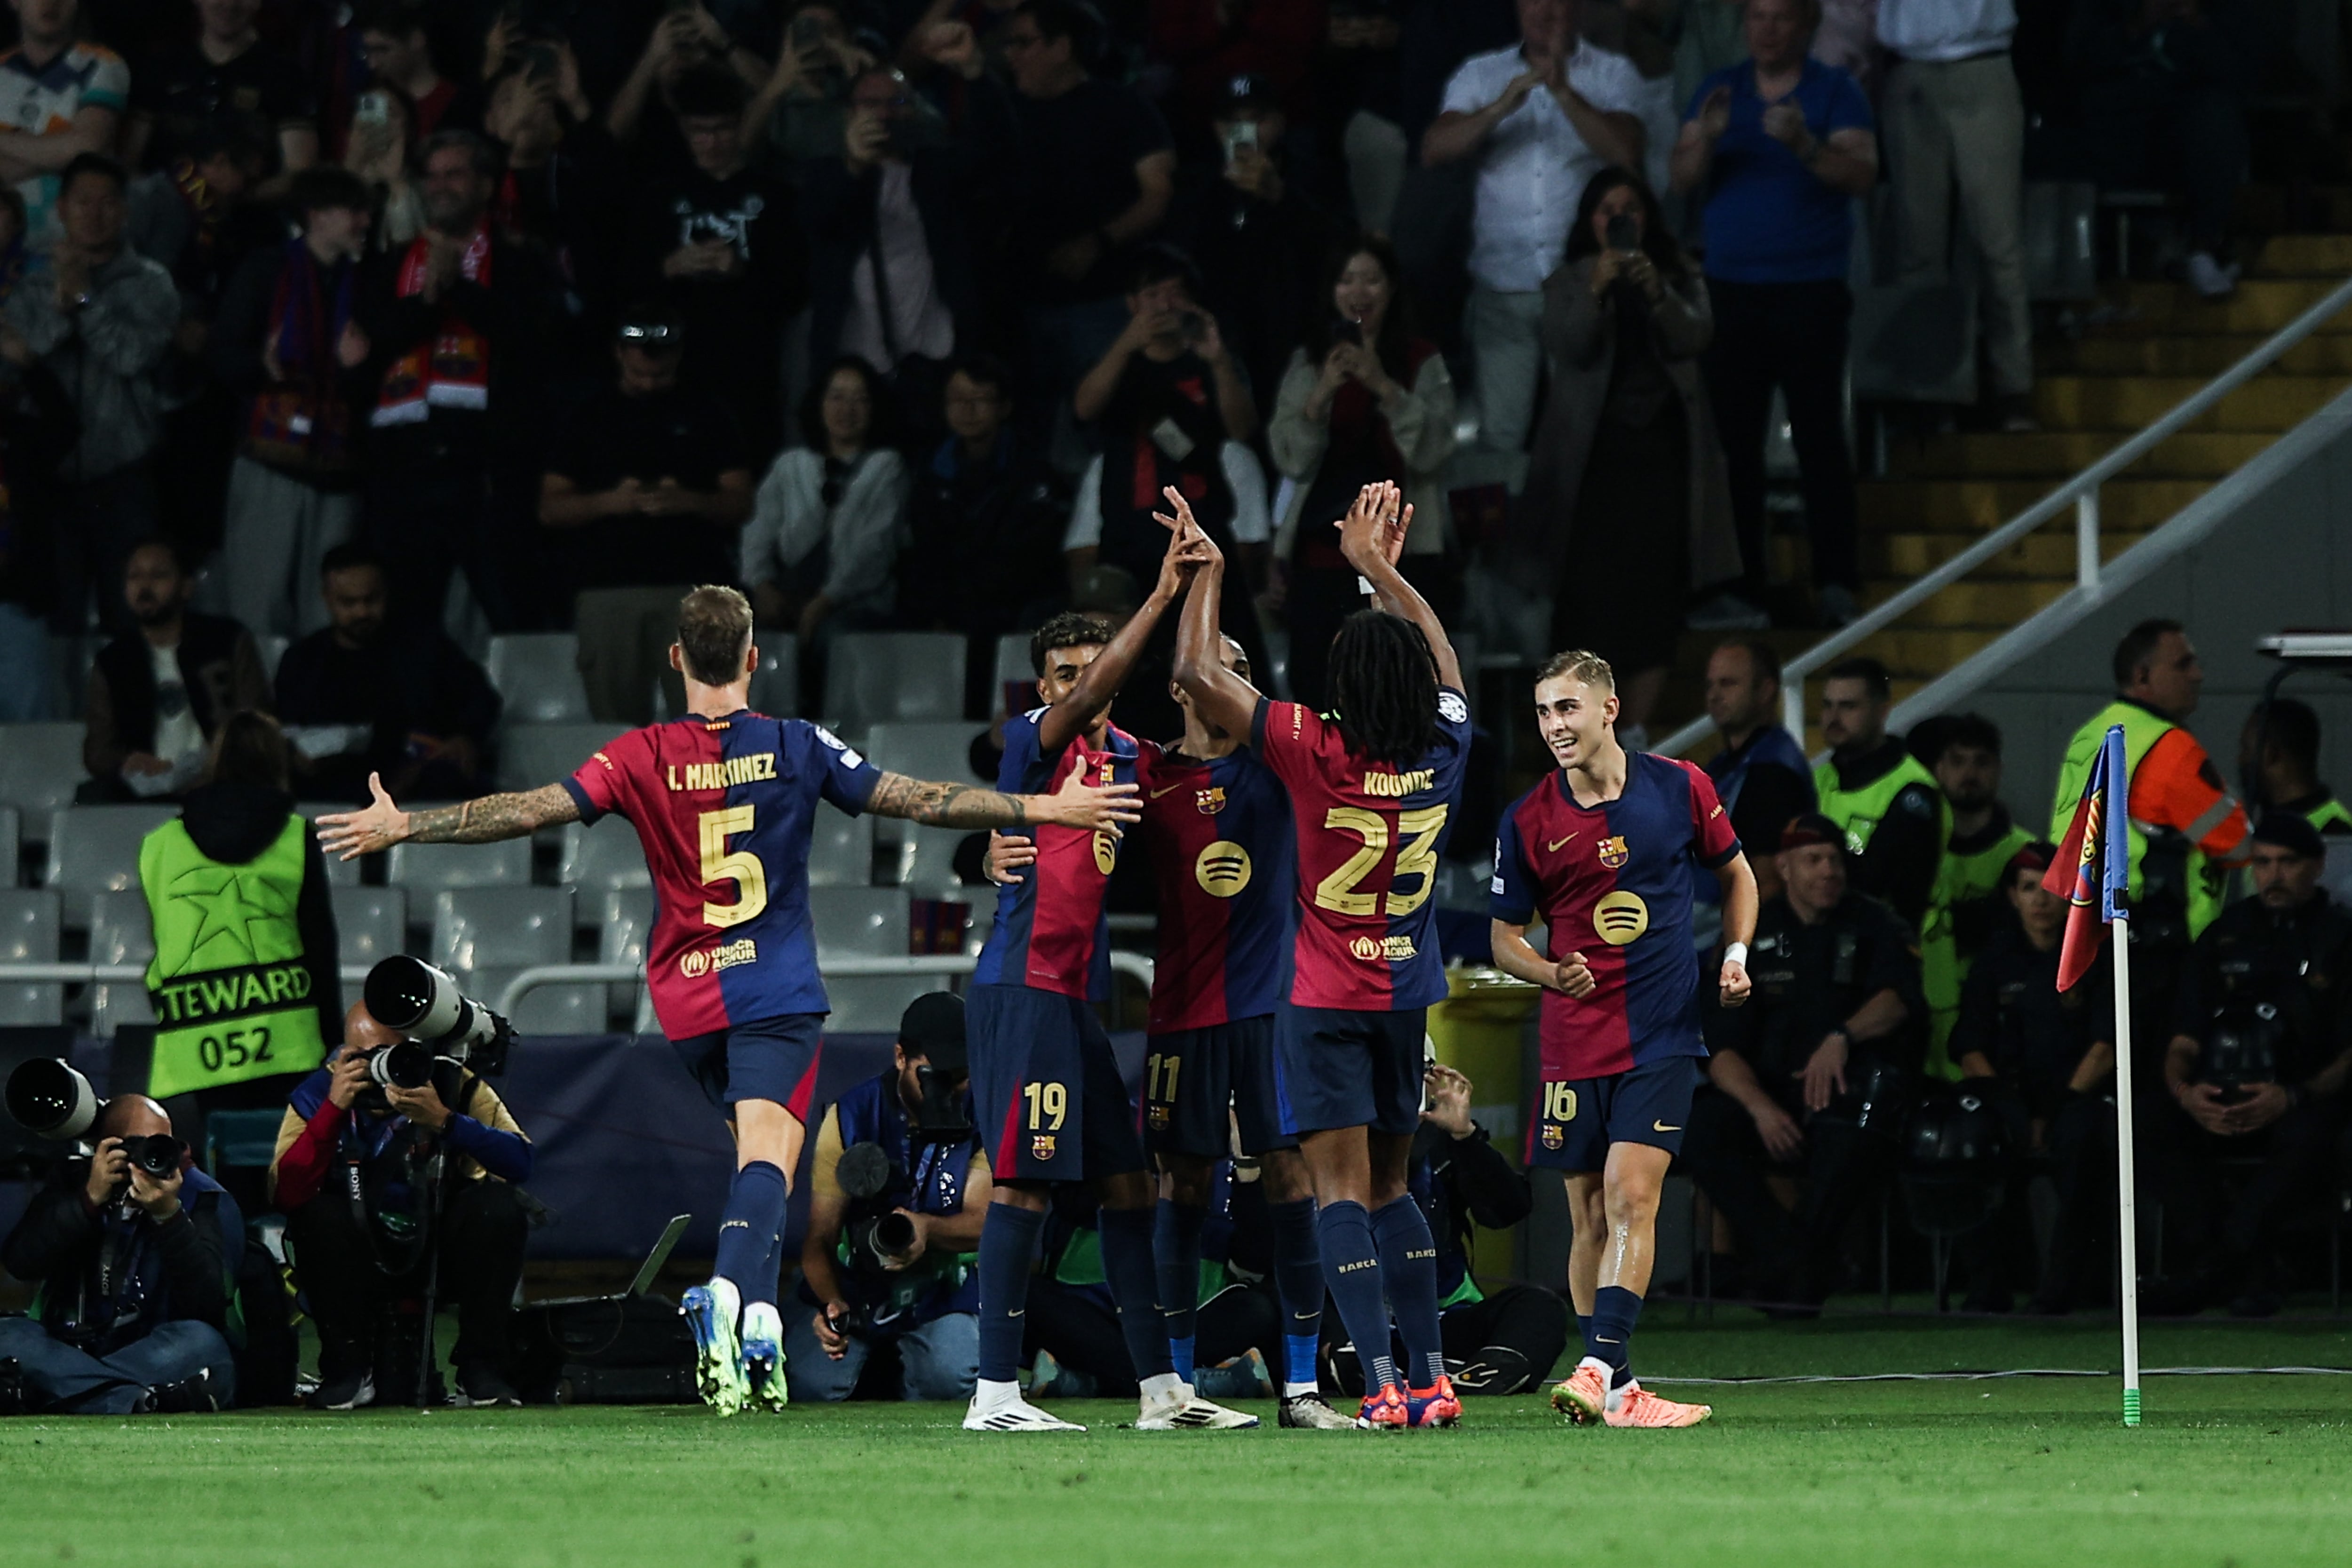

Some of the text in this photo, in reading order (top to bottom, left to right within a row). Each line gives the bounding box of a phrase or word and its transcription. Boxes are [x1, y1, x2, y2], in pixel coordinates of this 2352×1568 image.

[698, 804, 768, 929] 5
[1314, 803, 1448, 916] 23
[157, 965, 312, 1023] TEWARD
[200, 1027, 274, 1070] 052
[1148, 1053, 1181, 1103] 11
[1543, 1081, 1577, 1122] 16
[1024, 1082, 1067, 1130] 19
[350, 1166, 361, 1201] SONY
